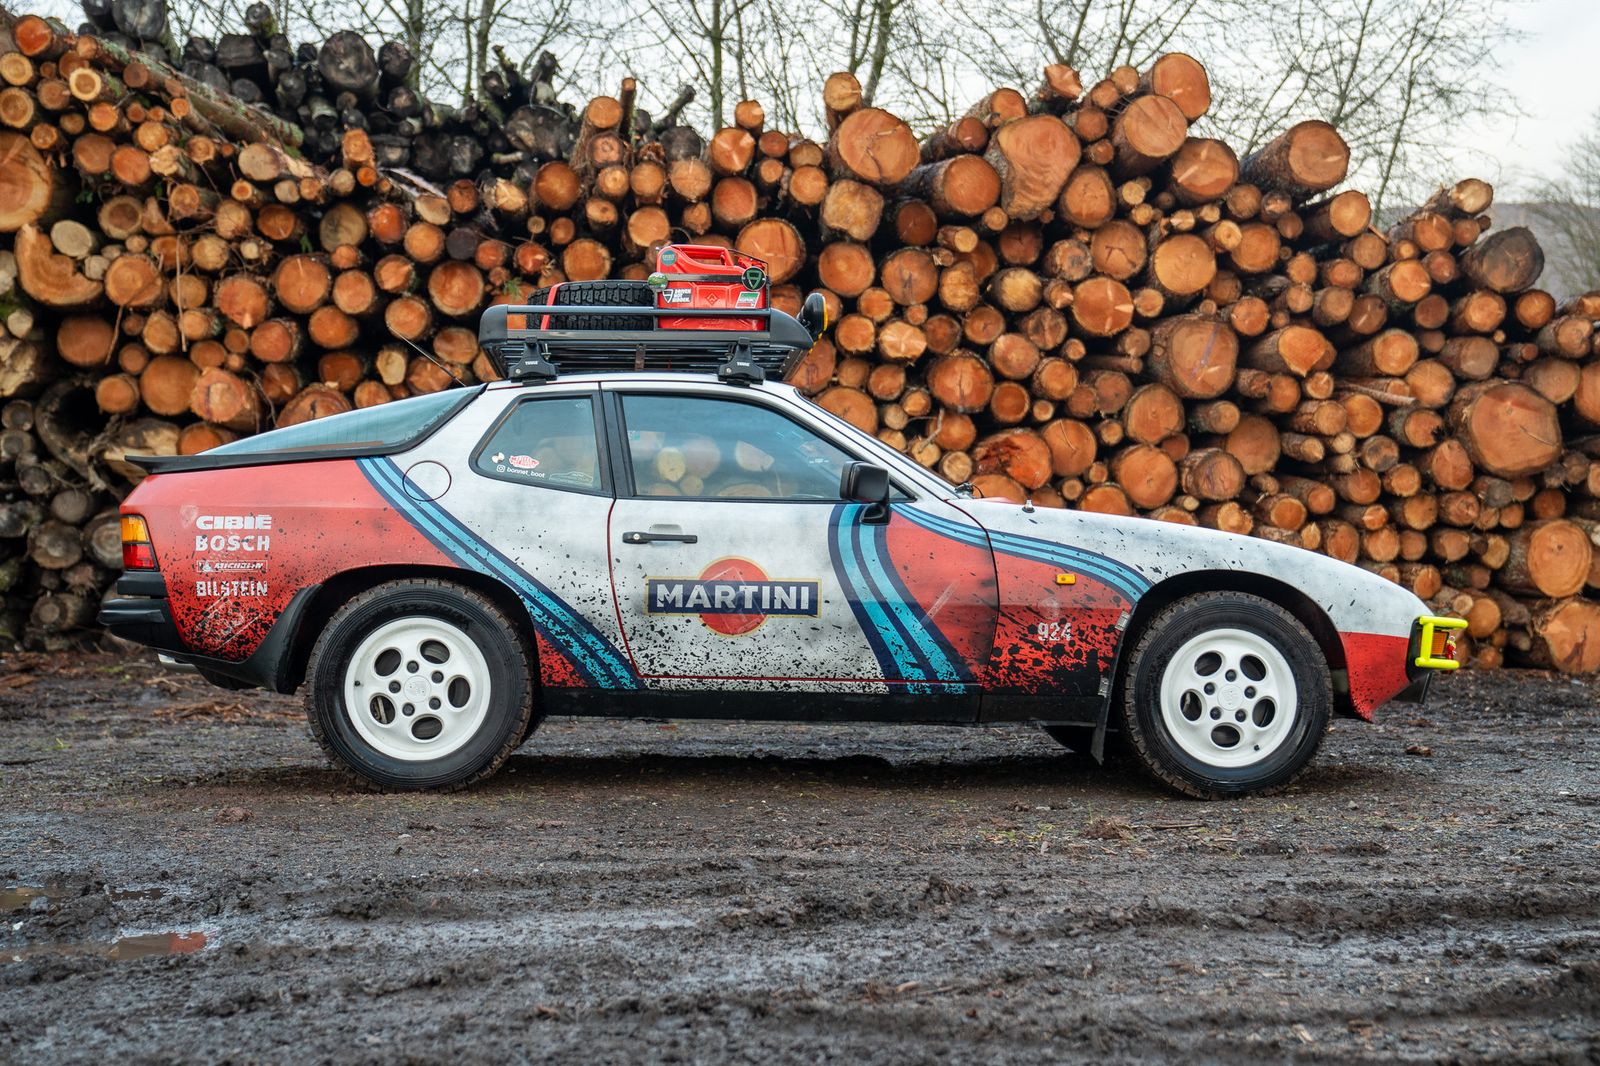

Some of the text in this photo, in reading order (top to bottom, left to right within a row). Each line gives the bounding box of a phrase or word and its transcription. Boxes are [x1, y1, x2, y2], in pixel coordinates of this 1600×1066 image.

[195, 535, 270, 551] BOSCH
[195, 581, 268, 597] BILSTEIN
[656, 584, 810, 610] MARTINI
[1037, 622, 1072, 641] 924
